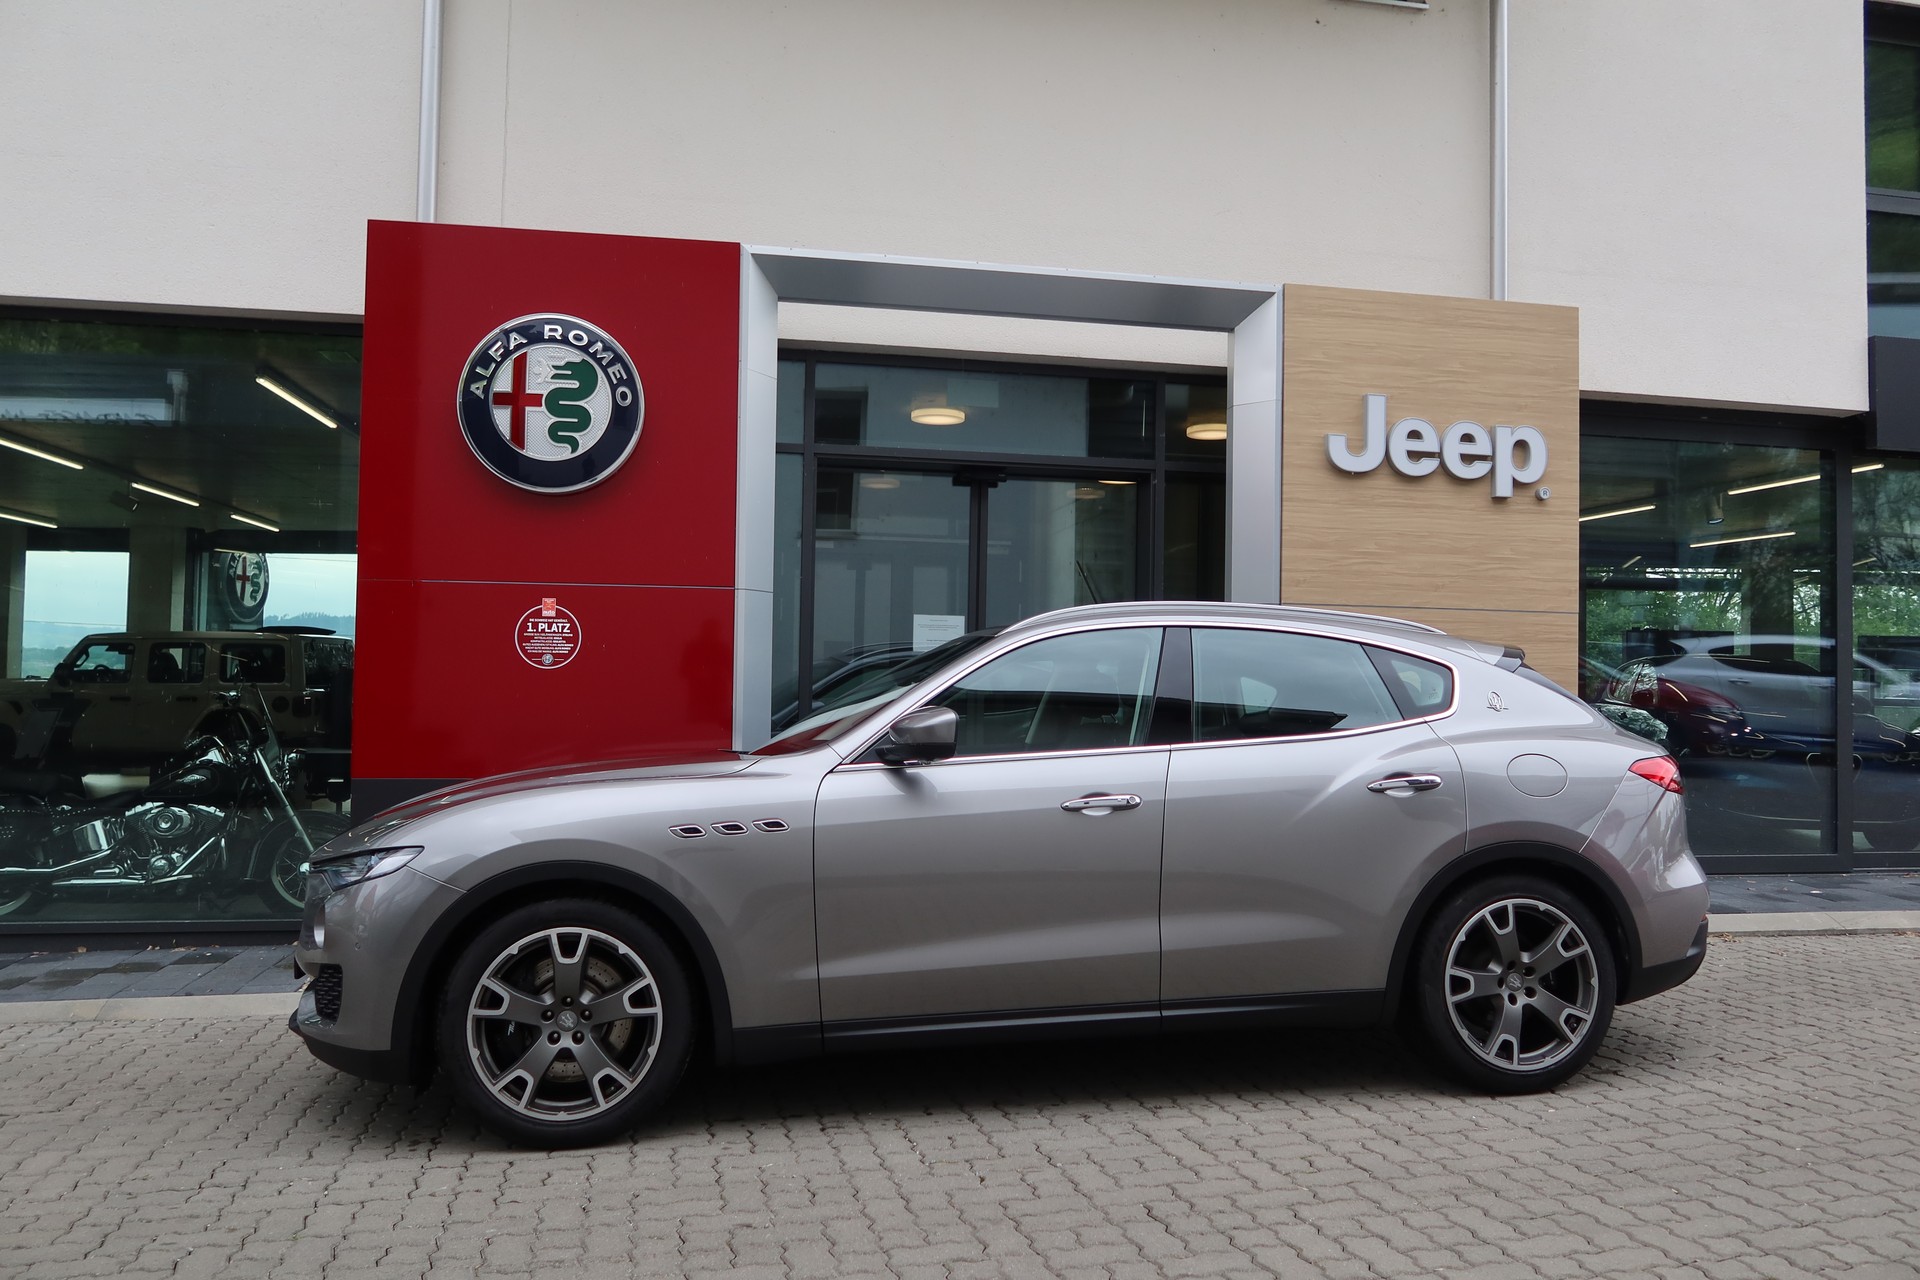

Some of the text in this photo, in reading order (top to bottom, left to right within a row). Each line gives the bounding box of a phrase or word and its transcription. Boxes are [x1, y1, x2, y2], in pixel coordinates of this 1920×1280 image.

[469, 324, 633, 407] ALFA ROMEO
[1324, 392, 1549, 499] Jeep
[526, 622, 571, 633] 1. PLATZ
